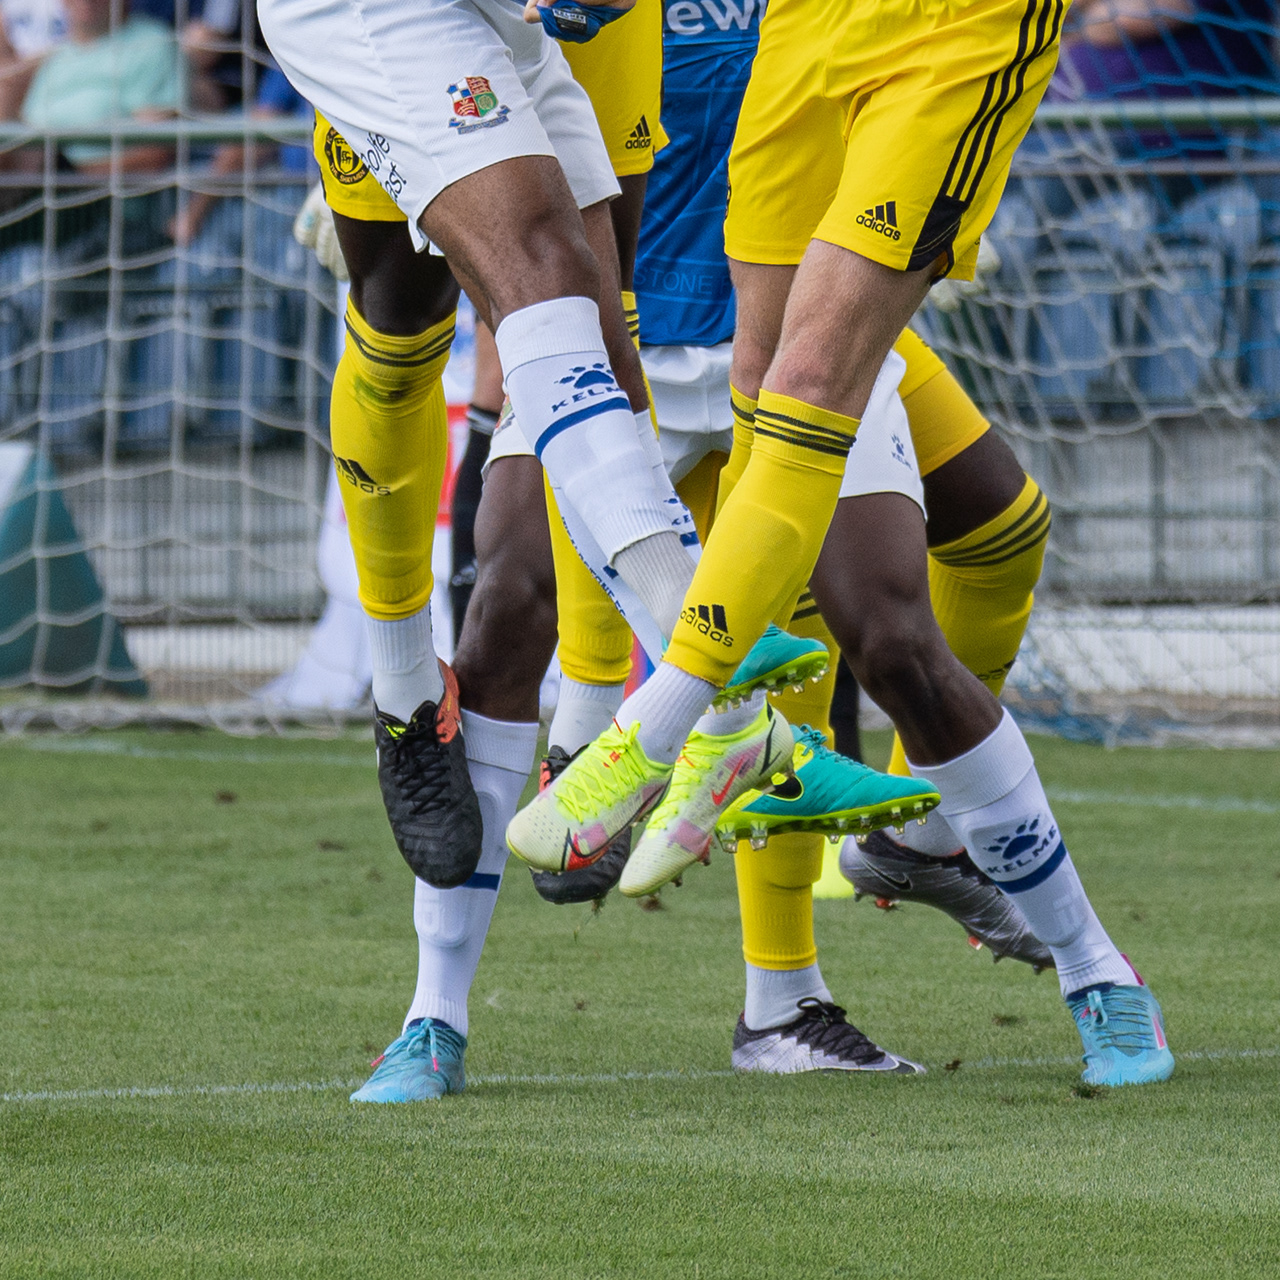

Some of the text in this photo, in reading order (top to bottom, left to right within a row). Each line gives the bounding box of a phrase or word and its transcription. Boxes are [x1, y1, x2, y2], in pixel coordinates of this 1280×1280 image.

[625, 137, 651, 149] adida
[856, 214, 901, 241] adidas
[551, 387, 624, 413] KELM
[680, 610, 734, 647] adidas
[986, 825, 1056, 873] KELME
